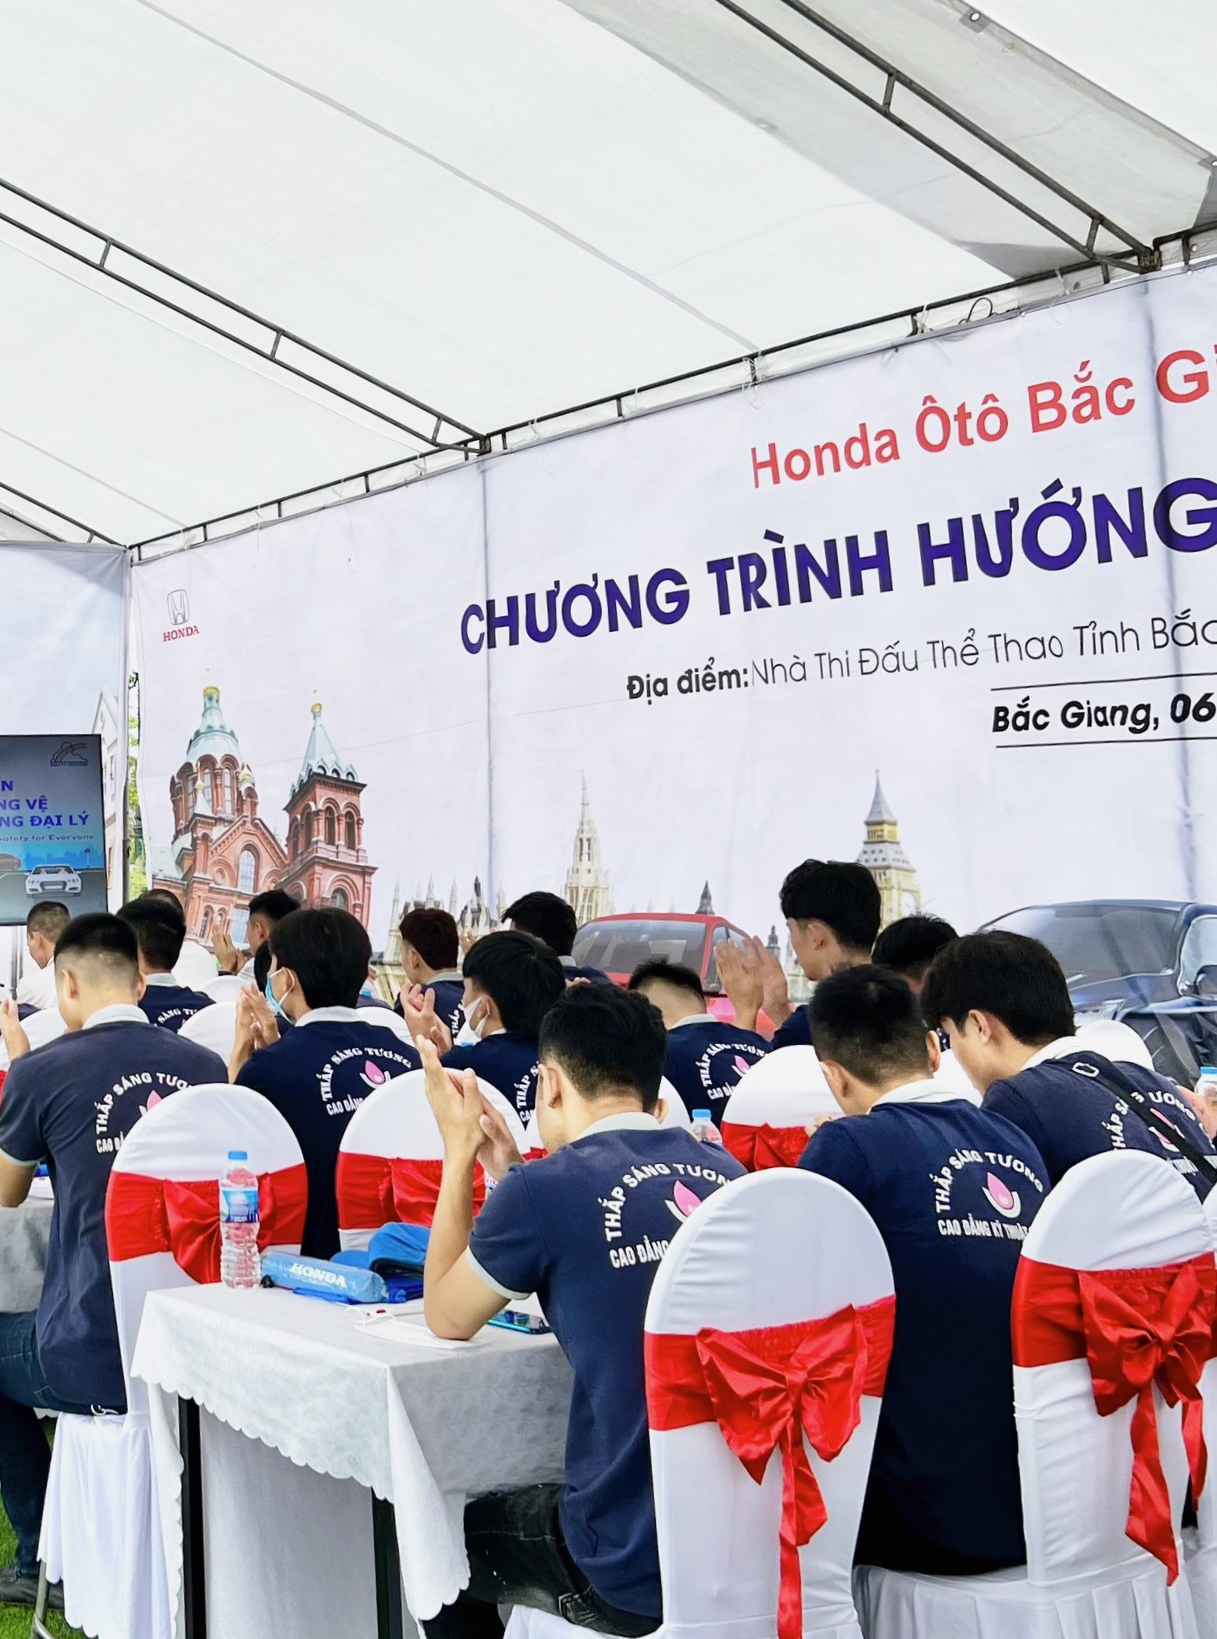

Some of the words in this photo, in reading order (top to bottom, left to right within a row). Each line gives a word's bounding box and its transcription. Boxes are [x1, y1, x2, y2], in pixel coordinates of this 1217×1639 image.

[750, 422, 901, 490] Honda
[915, 394, 1009, 454] Ôtô
[1027, 359, 1136, 434] Bắc
[460, 568, 690, 656] CHƯƠNG
[706, 529, 894, 616] TRÌNH
[916, 477, 1217, 588] HƯỚNG
[162, 625, 200, 642] HONDA
[627, 675, 669, 705] Địa
[677, 657, 749, 696] điểm:
[751, 654, 808, 687] Nhà
[814, 650, 851, 680] Thi
[858, 640, 919, 676] Đấu
[927, 629, 979, 668] Thể
[988, 633, 1064, 663] Thao
[1073, 620, 1140, 656] Tỉnh
[992, 696, 1050, 733] Bắc
[1061, 699, 1159, 735] Giang,
[26, 794, 49, 812] VỆ
[29, 814, 63, 828] ĐẠI
[69, 810, 90, 826] LÝ
[113, 1072, 152, 1096] SÁNG
[326, 1101, 344, 1116] CAO
[96, 1137, 113, 1153] CAO
[622, 1163, 671, 1188] SÁNG
[984, 1151, 1044, 1193] TƯƠNG
[937, 1219, 962, 1236] CAO
[609, 1246, 636, 1269] CAO
[289, 1262, 348, 1288] HONDA
